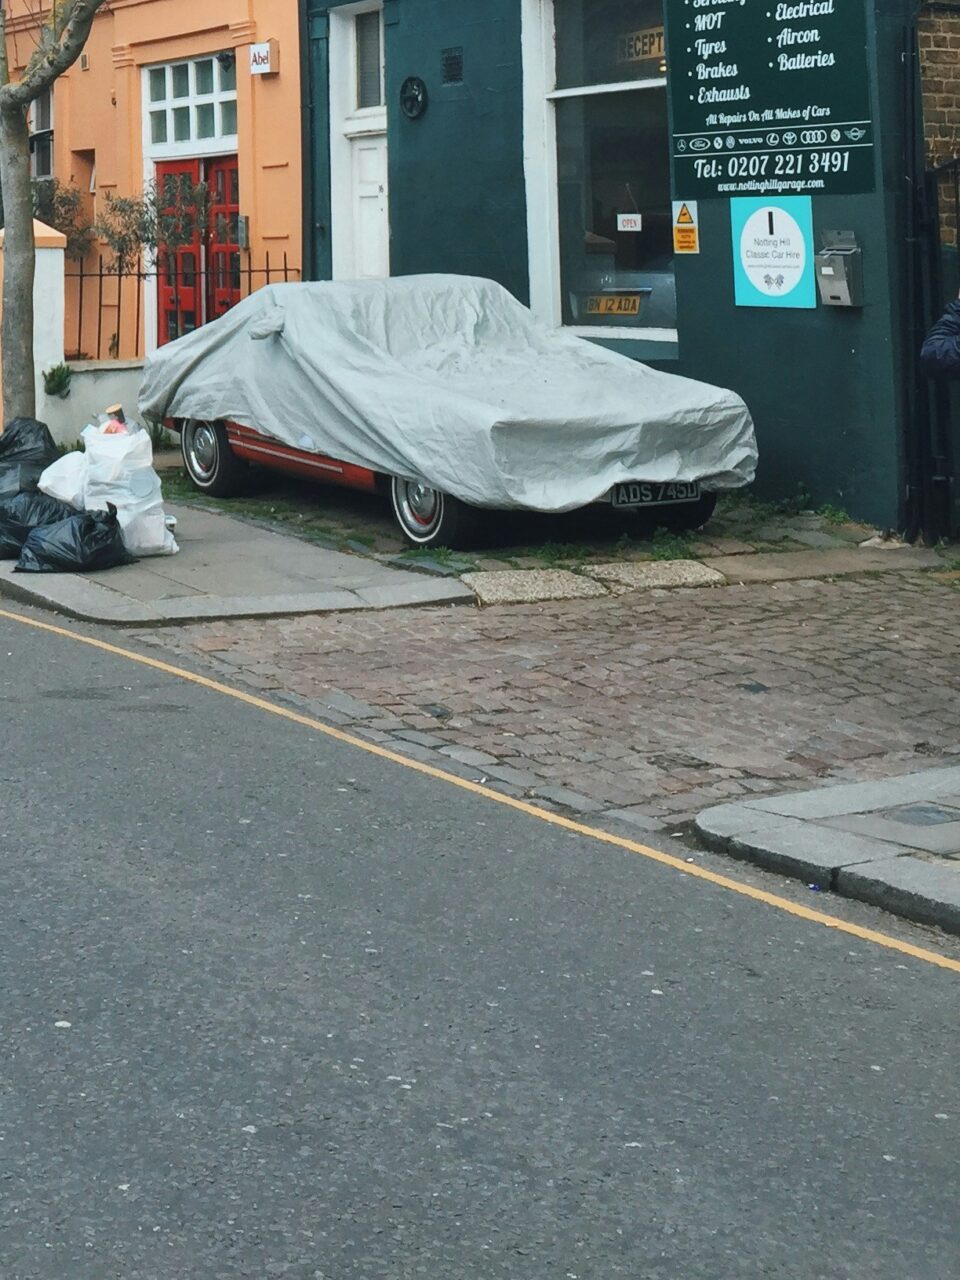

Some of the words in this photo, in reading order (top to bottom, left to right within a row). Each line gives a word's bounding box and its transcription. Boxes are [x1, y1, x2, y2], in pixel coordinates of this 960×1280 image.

[694, 12, 726, 32] MOT
[776, 28, 821, 48] Aircon
[695, 38, 727, 60] Tyres
[777, 50, 836, 71] Batteries
[696, 62, 738, 80] Brakes
[698, 84, 751, 104] Exhausts
[706, 113, 717, 126] All
[719, 112, 746, 126] Repairs
[748, 110, 760, 122] On
[761, 109, 774, 122] All
[775, 107, 801, 120] Makes
[802, 106, 812, 121] of
[811, 105, 831, 117] Cars
[738, 137, 764, 145] VOLVO
[694, 159, 722, 178] Tel:
[728, 155, 770, 177] 0207
[775, 154, 803, 175] 221
[809, 151, 850, 173] 3491
[717, 179, 825, 193] www.nottinghillgarage.com
[622, 218, 638, 228] OPEN
[753, 238, 778, 248] Notting
[780, 238, 791, 247] Hill
[746, 250, 769, 259] Classic
[772, 250, 784, 259] Car
[786, 251, 800, 260] Hire
[618, 484, 653, 504] ADS
